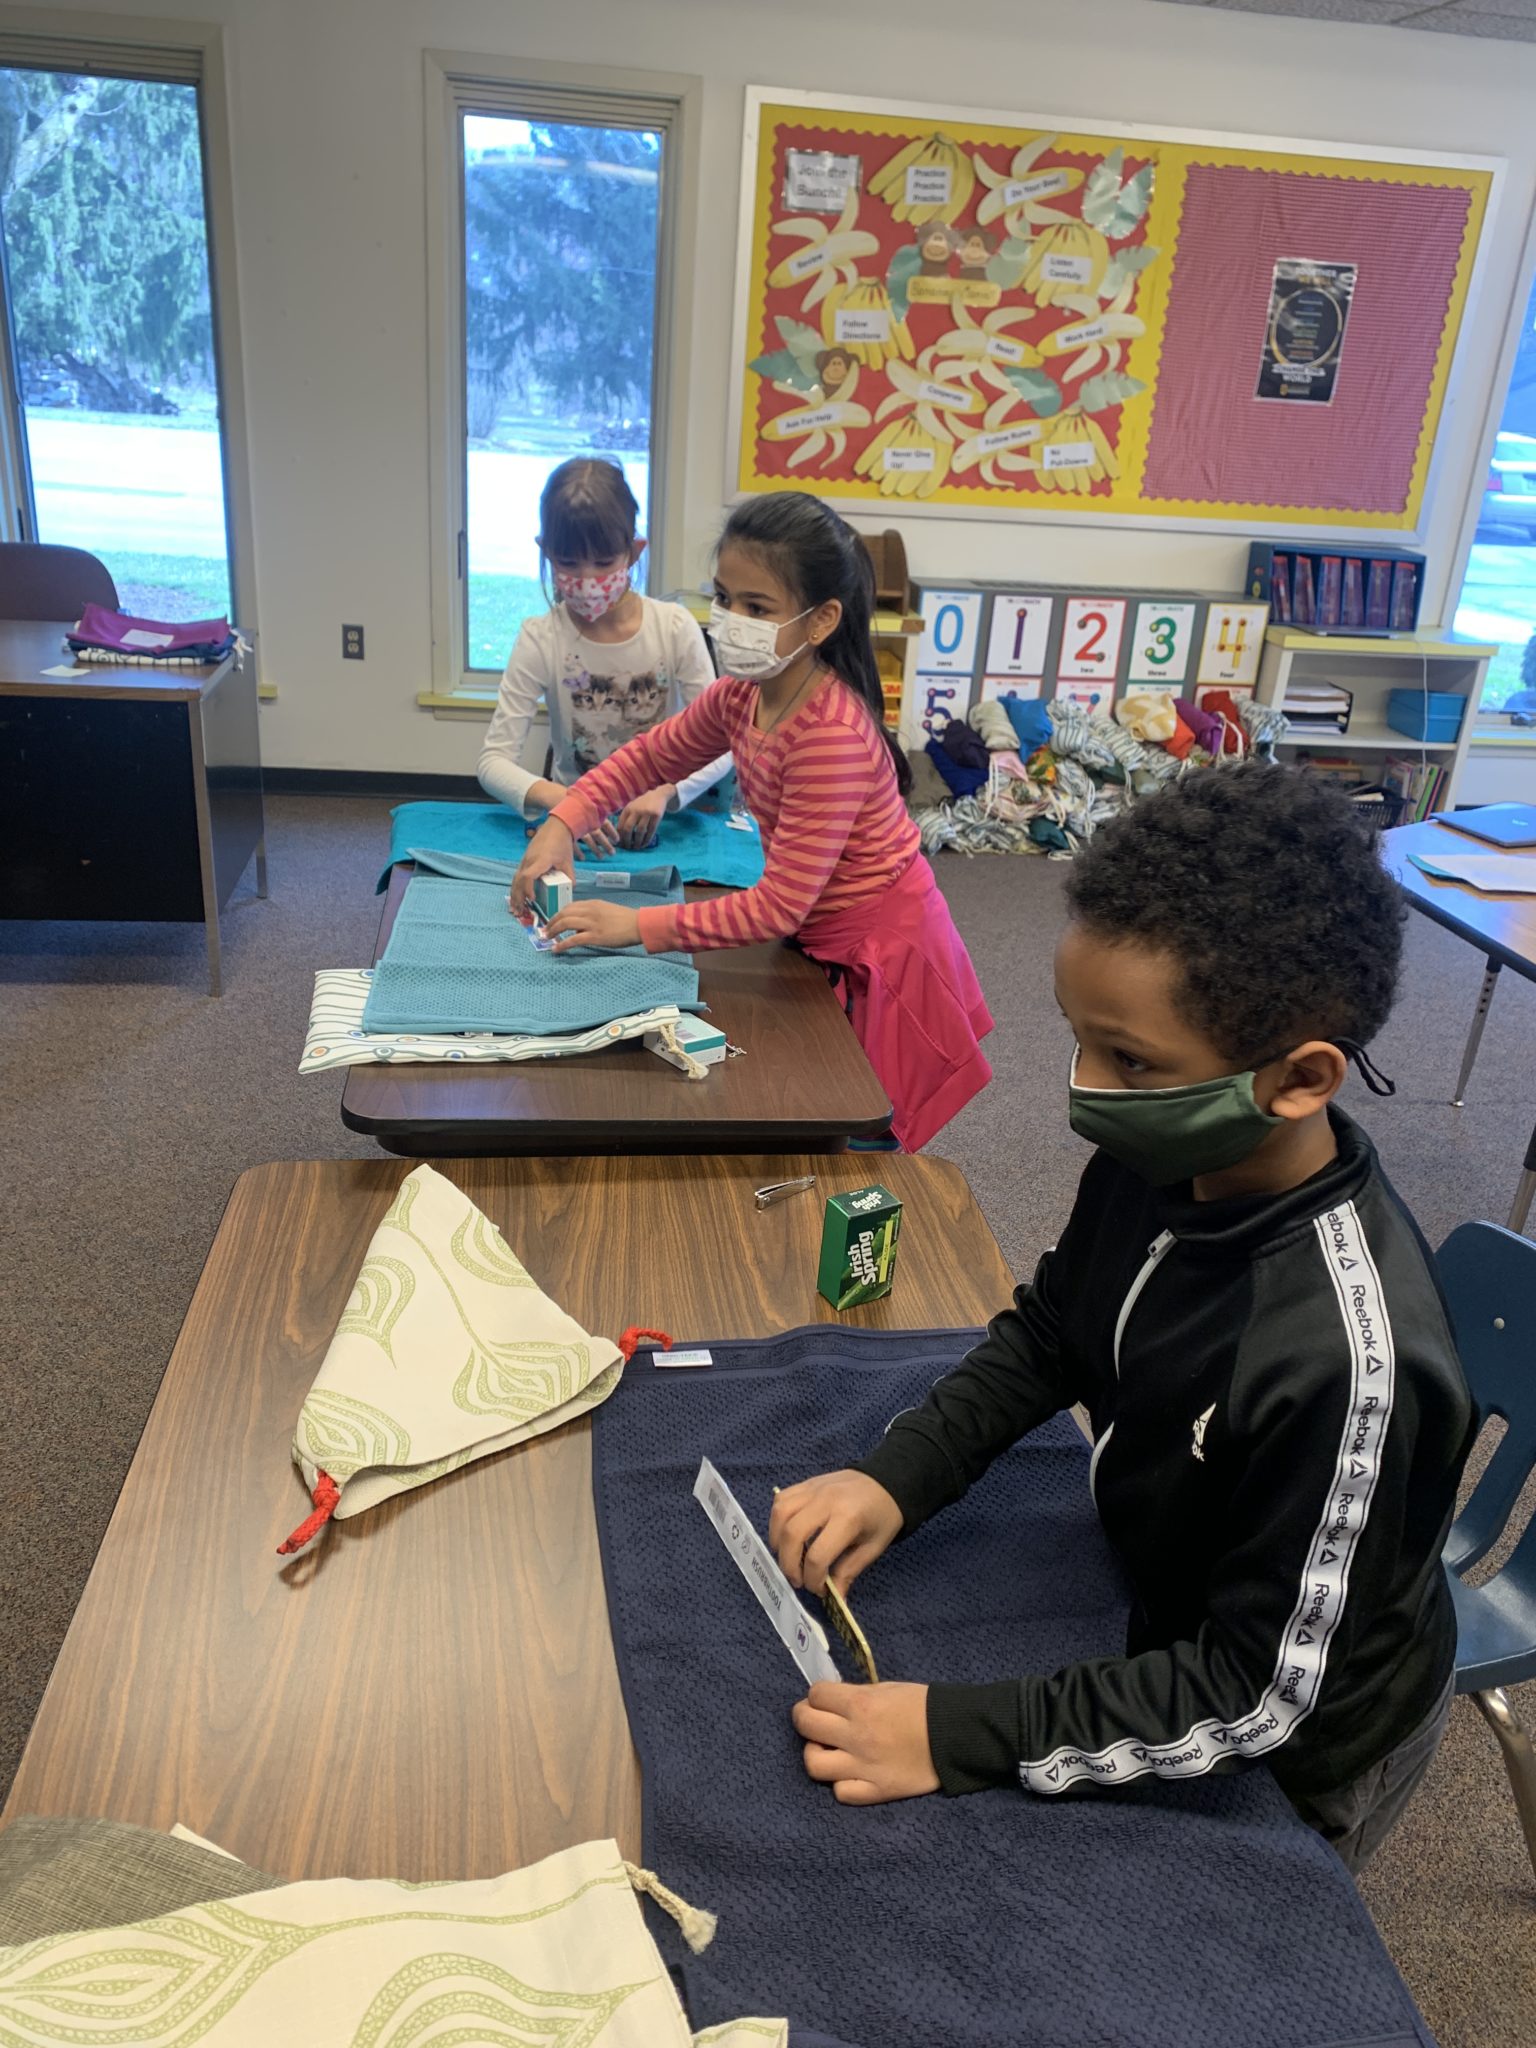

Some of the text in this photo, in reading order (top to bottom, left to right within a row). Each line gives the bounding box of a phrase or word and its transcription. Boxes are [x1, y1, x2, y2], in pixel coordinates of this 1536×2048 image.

[913, 181, 945, 190] Practice
[914, 168, 946, 177] Practice
[912, 194, 944, 203] Practice
[1050, 257, 1073, 266] Listen
[842, 320, 868, 328] Follow
[842, 331, 881, 340] Directions
[927, 384, 965, 402] Cooperate
[934, 604, 964, 654] 0
[1013, 608, 1028, 660] 1
[1073, 612, 1108, 661] 2
[1144, 617, 1177, 665] 3
[1216, 616, 1248, 669] 4
[1080, 666, 1095, 674] two
[921, 687, 956, 740] 5
[852, 1191, 882, 1209] Spring
[847, 1243, 864, 1278] Irish
[858, 1230, 878, 1286] Spring
[1350, 1284, 1378, 1351] Reebok
[1351, 1396, 1379, 1456] Reebok
[751, 1556, 782, 1612] TOOTHBRUSH
